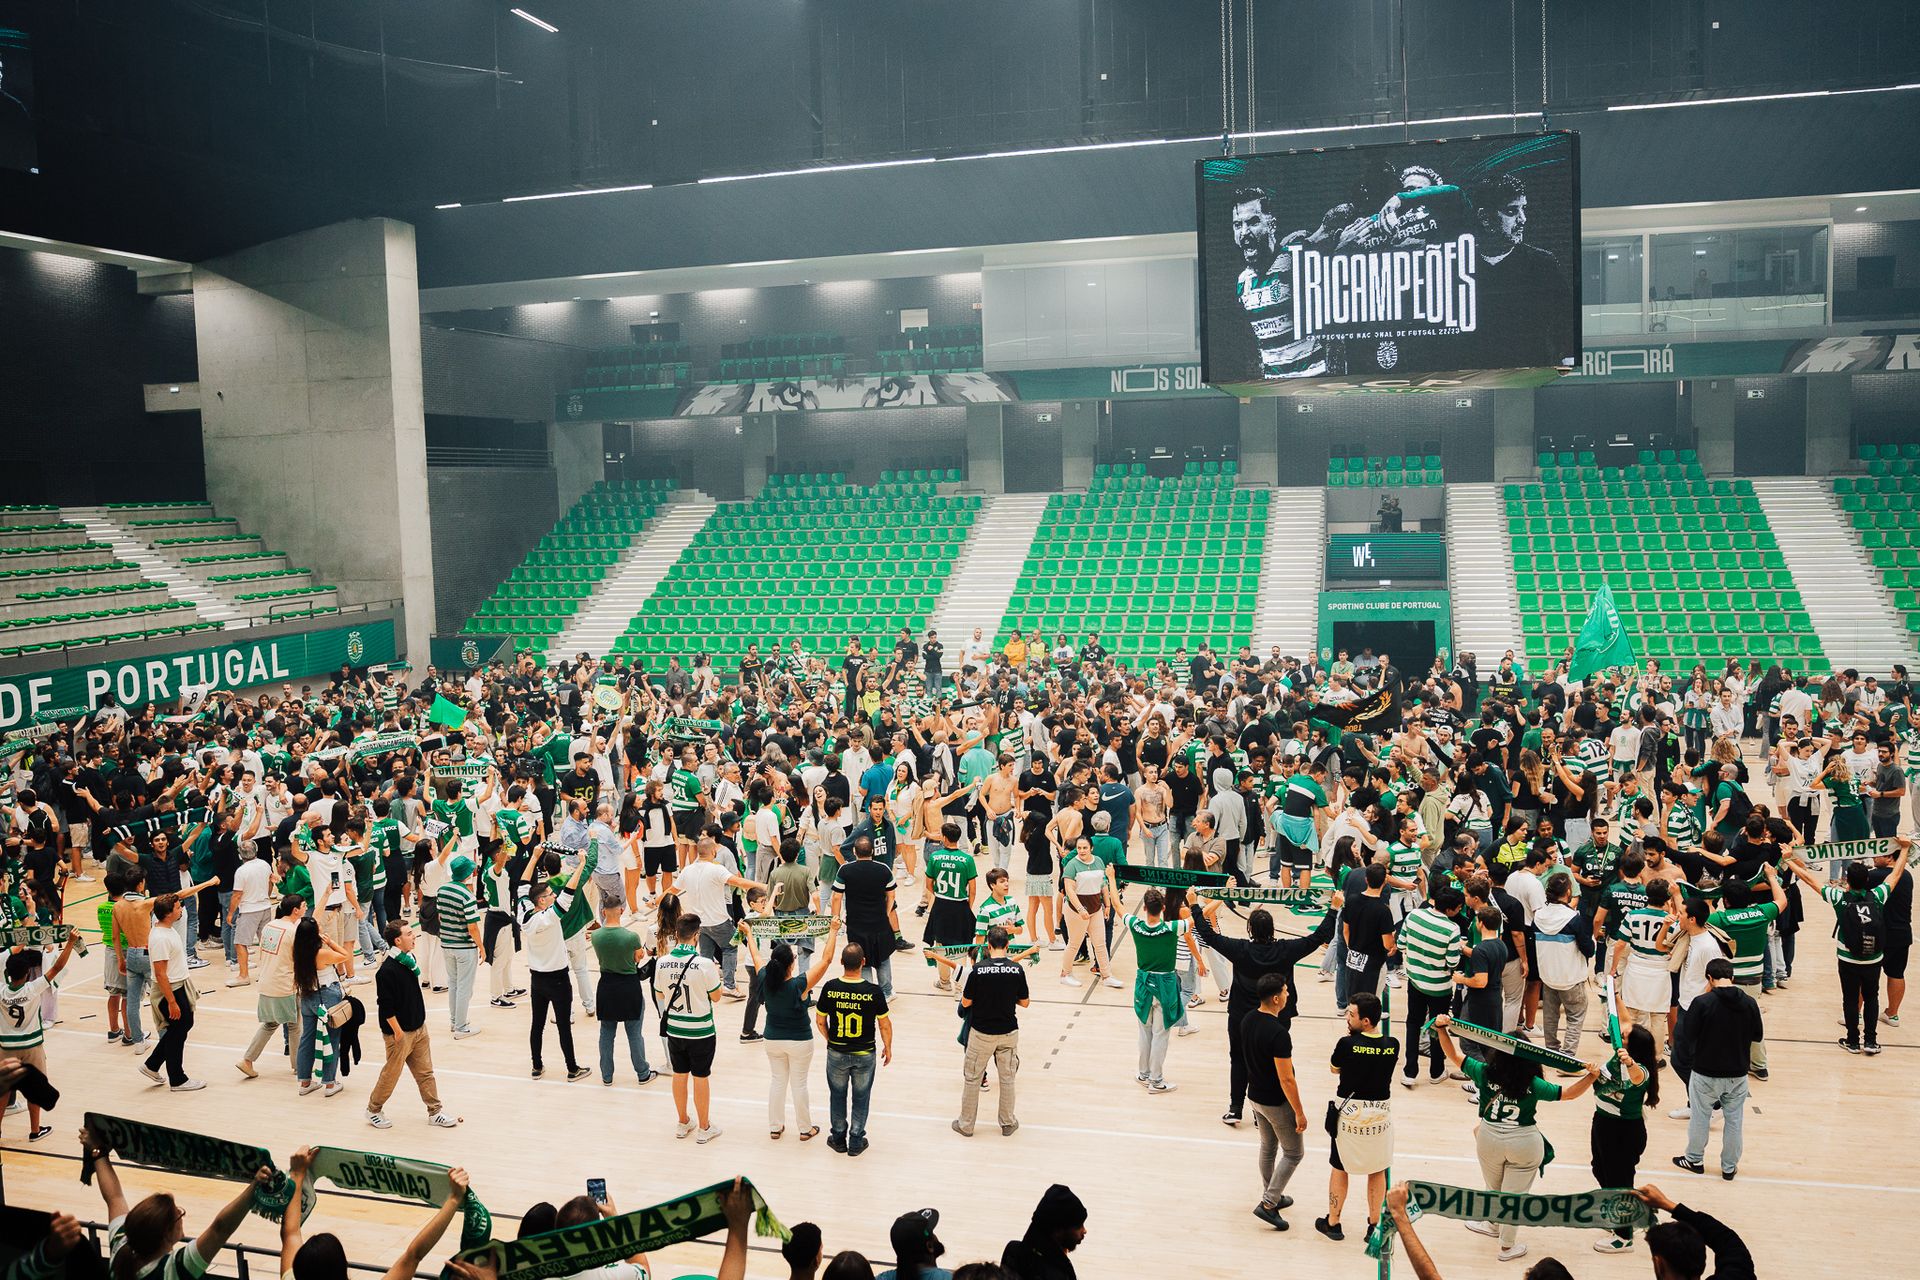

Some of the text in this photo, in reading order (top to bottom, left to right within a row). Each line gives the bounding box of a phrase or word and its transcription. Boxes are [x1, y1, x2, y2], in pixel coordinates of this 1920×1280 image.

[1288, 233, 1477, 341] TRICAMPEÕES
[1111, 364, 1169, 393] NÓS
[1328, 602, 1365, 610] SPORTING
[1366, 602, 1390, 610] CLUBE
[1402, 601, 1442, 609] PORTUGAL
[87, 643, 289, 711] PORTUGAL
[190, 692, 198, 704] 8
[574, 785, 594, 801] 5G
[951, 855, 967, 863] BOCK
[936, 870, 961, 897] 64
[1612, 891, 1648, 902] SUPER BOC
[1727, 912, 1748, 922] SUPER
[659, 961, 679, 970] SUPER
[977, 966, 1020, 975] SUPER BOCK
[668, 982, 692, 1014] 21
[827, 990, 873, 1002] SUPER BOCK
[836, 1001, 861, 1010] MIGUEL
[8, 1004, 25, 1028] 9
[836, 1011, 863, 1038] 10
[1353, 1045, 1375, 1055] SUPER
[1342, 1103, 1358, 1116] LOS
